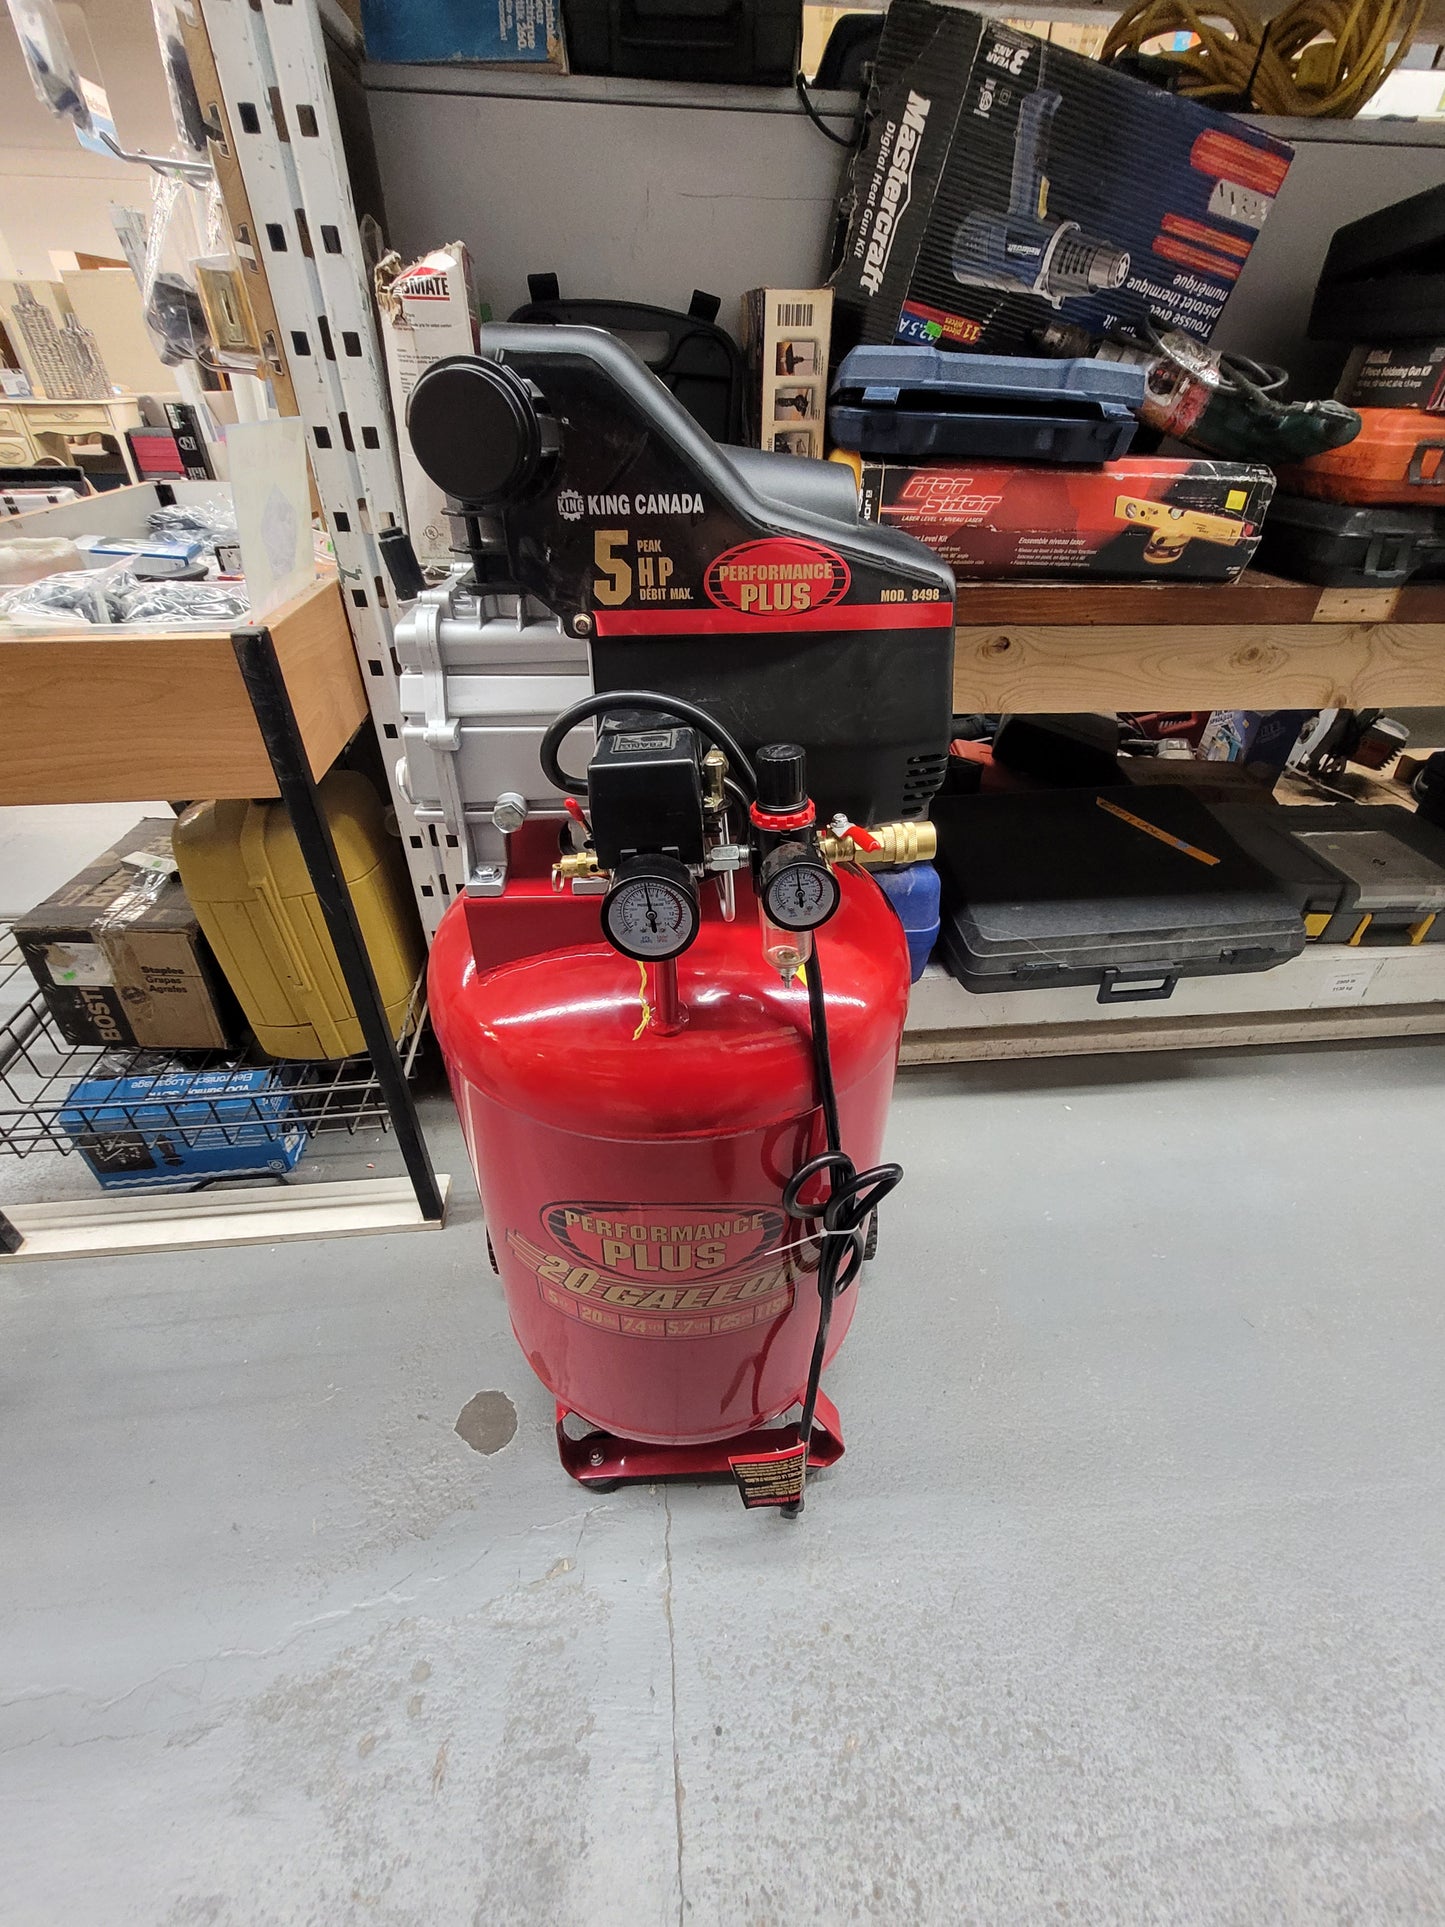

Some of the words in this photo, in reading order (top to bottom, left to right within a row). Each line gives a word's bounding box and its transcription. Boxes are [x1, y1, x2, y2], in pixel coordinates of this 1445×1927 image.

[986, 51, 1010, 70] YEAR
[992, 43, 1014, 58] ANS
[1009, 48, 1030, 75] 3
[878, 120, 896, 172] Digital
[860, 89, 931, 297] Mastercraft
[868, 172, 883, 207] Heat
[859, 209, 873, 236] Gun
[854, 238, 867, 259] Kit
[1126, 277, 1181, 308] thermique
[1172, 274, 1230, 302] numérique
[1178, 296, 1223, 320] pistolet
[898, 317, 910, 333] A
[962, 324, 980, 340] 11
[1172, 313, 1213, 338] Trousse
[1381, 366, 1408, 378] Soldering
[1409, 366, 1422, 376] Gun
[1422, 366, 1432, 376] Kit
[903, 476, 974, 498] HOT
[558, 498, 584, 512] KING
[587, 494, 631, 515] KING
[635, 493, 704, 514] CANADA
[920, 496, 1002, 515] SHOT
[637, 540, 662, 553] PEAK
[594, 530, 632, 606] 5
[638, 556, 674, 587] HP
[719, 562, 833, 582] PERFORMANCE
[640, 586, 666, 600] DÉBIT
[670, 588, 694, 600] MAX.
[740, 582, 812, 611] PLUS
[880, 589, 908, 602] MOD.
[911, 588, 940, 601] 8498
[140, 966, 185, 976] Staples
[146, 975, 182, 985] Grapas
[150, 985, 188, 994] Agrafes
[564, 1210, 766, 1242] PERFORMANCE
[602, 1238, 728, 1273] PLUS
[537, 1254, 600, 1295] 20
[582, 1308, 602, 1322] 20
